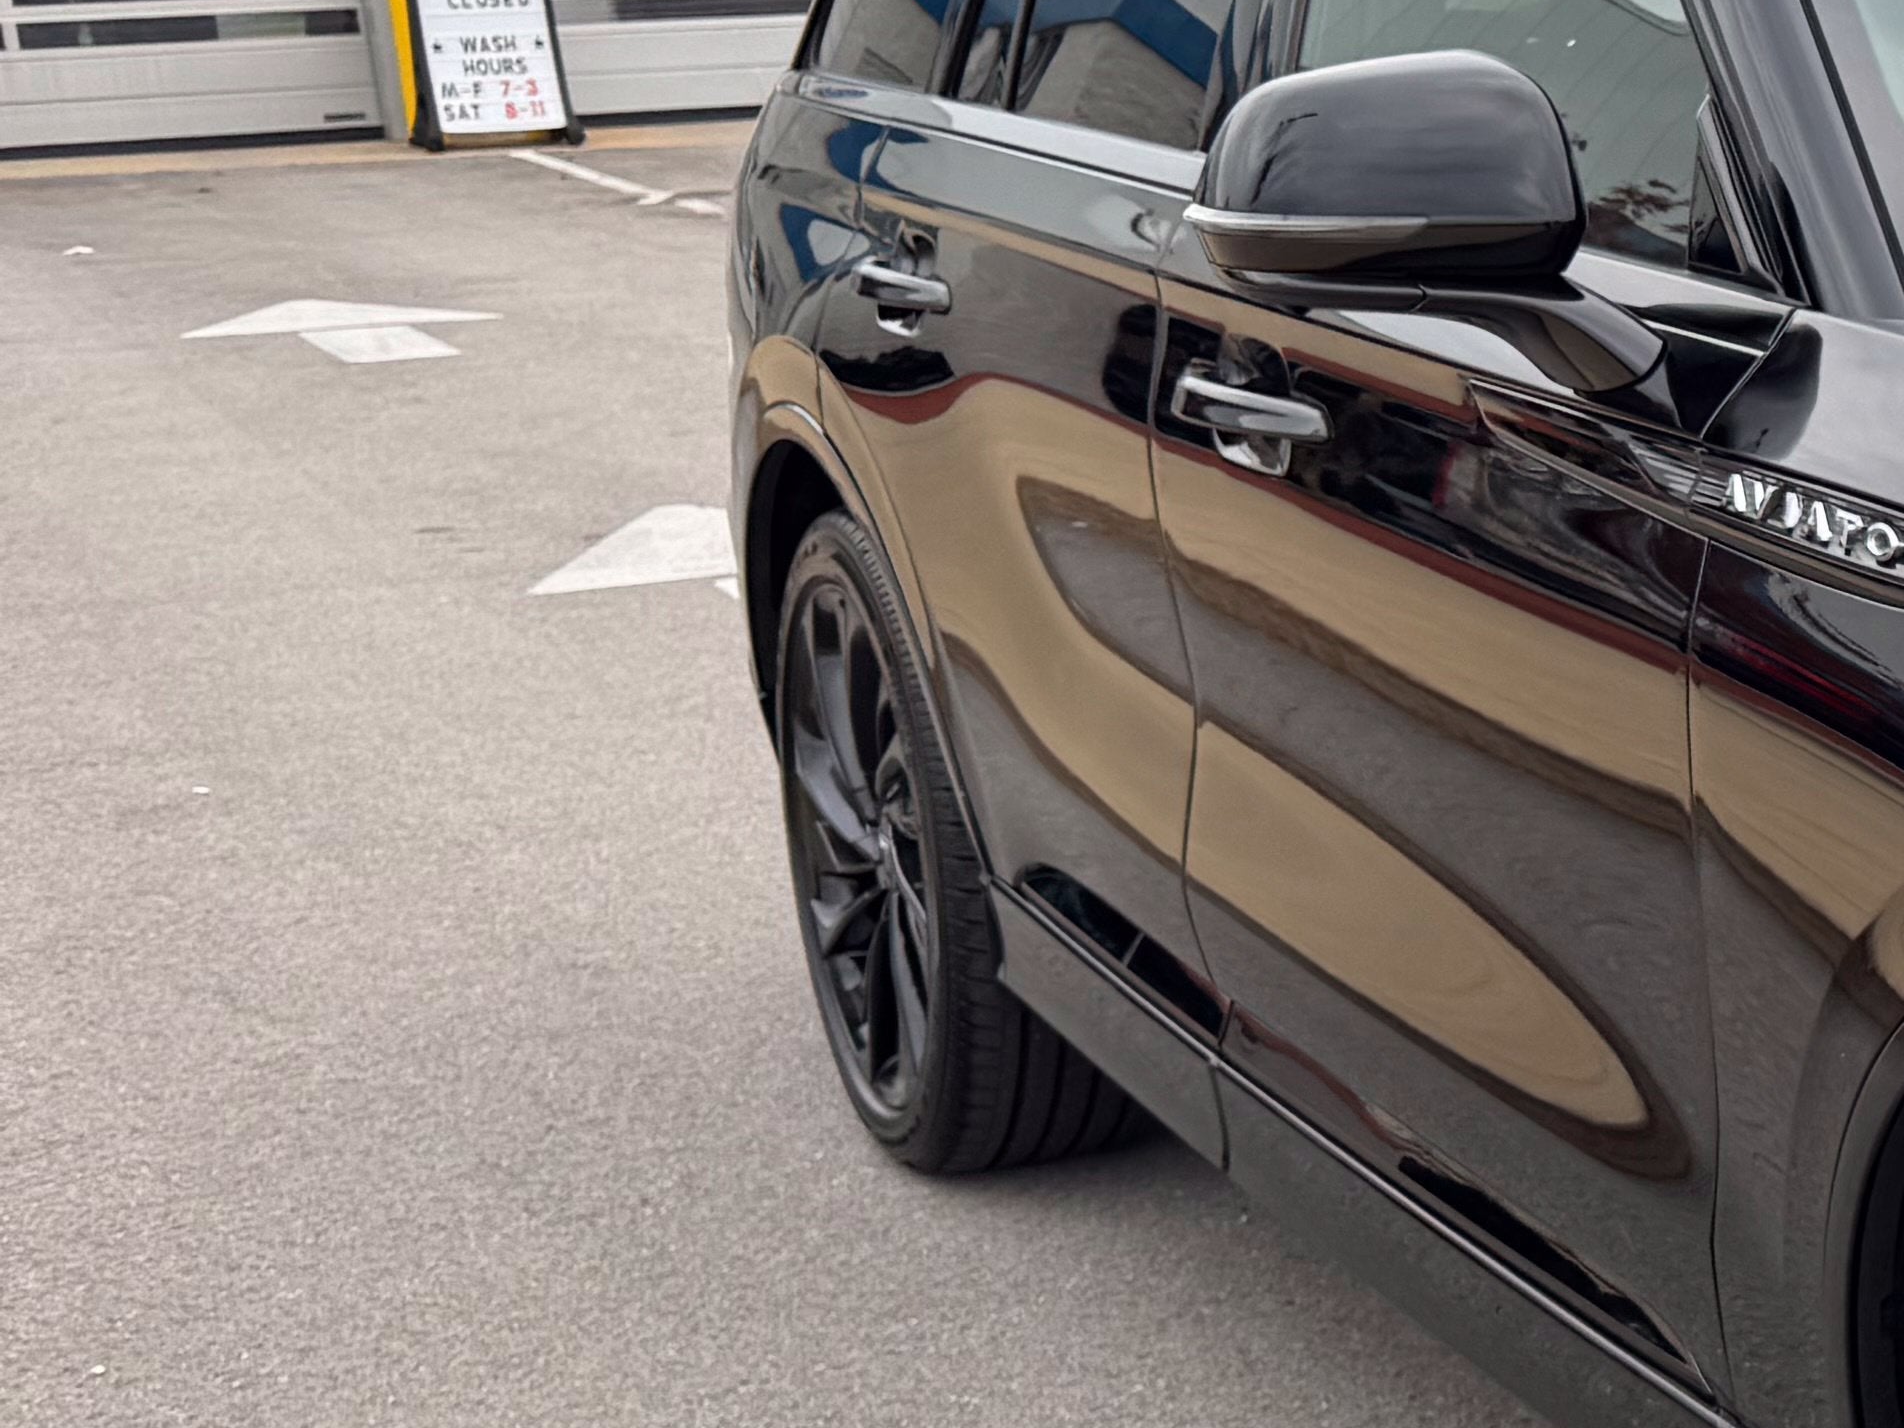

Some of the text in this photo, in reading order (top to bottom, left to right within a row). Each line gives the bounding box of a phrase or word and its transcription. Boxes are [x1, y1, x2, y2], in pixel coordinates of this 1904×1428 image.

[459, 35, 517, 54] WASH
[462, 56, 528, 76] HOURS
[444, 103, 481, 121] SAT
